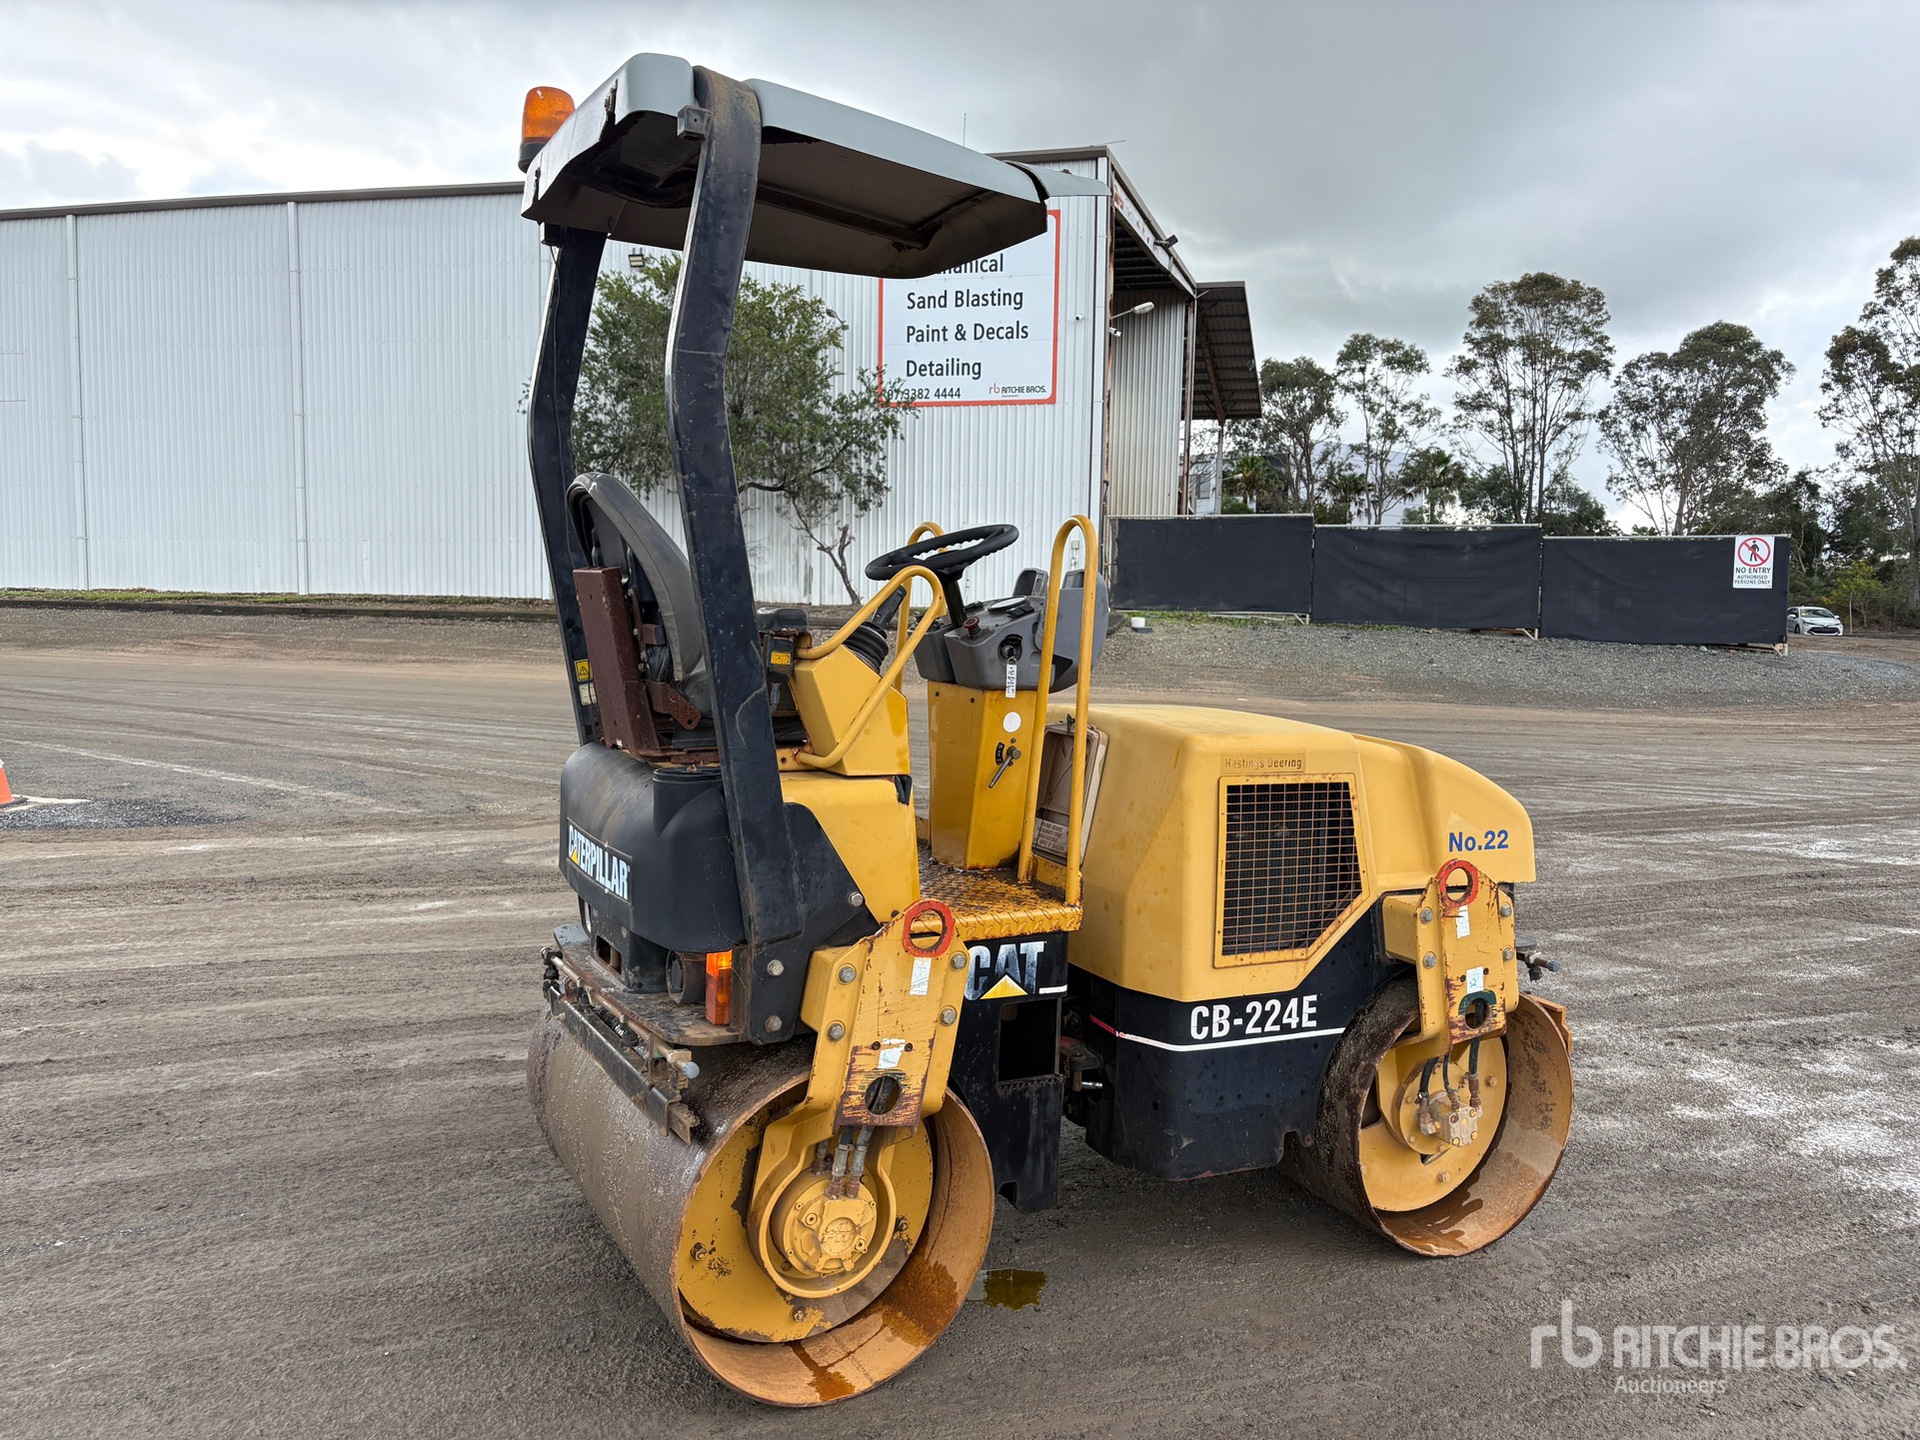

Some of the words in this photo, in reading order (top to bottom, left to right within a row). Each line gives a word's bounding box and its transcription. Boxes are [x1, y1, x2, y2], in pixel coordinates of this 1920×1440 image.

[937, 253, 1004, 275] anical
[906, 289, 948, 310] Sand
[954, 288, 1024, 310] Blasting
[906, 325, 948, 343] Paint
[954, 324, 967, 341] &
[973, 320, 1029, 340] Decals
[906, 357, 982, 380] Detailing
[903, 388, 930, 400] 3382
[934, 387, 961, 399] 4444
[1001, 386, 1025, 394] RITCHIE
[1267, 757, 1302, 770] Deering
[1449, 829, 1509, 852] No.22
[568, 824, 629, 900] CATERPILLAR
[964, 941, 1045, 1000] CAT
[1190, 994, 1318, 1040] CB-224E
